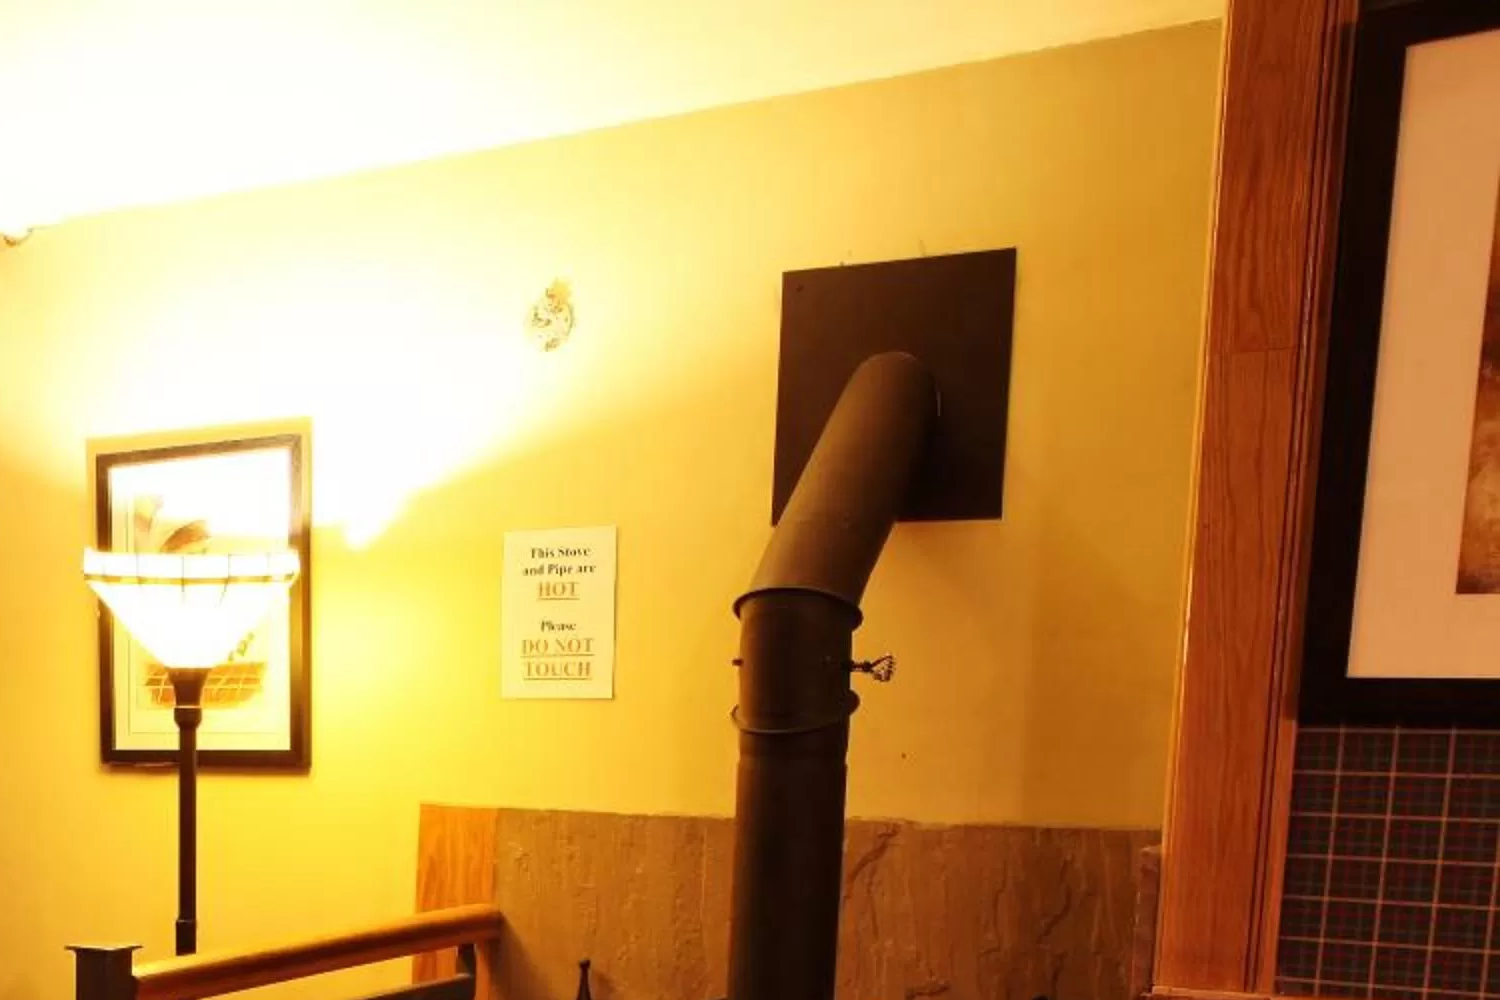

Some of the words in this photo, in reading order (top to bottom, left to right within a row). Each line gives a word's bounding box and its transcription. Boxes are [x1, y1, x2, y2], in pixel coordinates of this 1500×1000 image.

[531, 547, 555, 559] This
[557, 546, 591, 558] Stove
[522, 564, 544, 576] and
[547, 563, 573, 577] Pipe
[576, 564, 596, 574] are
[538, 581, 580, 597] HOT
[541, 620, 577, 633] Please
[521, 639, 549, 655] DO
[555, 637, 594, 653] NOT
[525, 661, 591, 677] TOUCH
